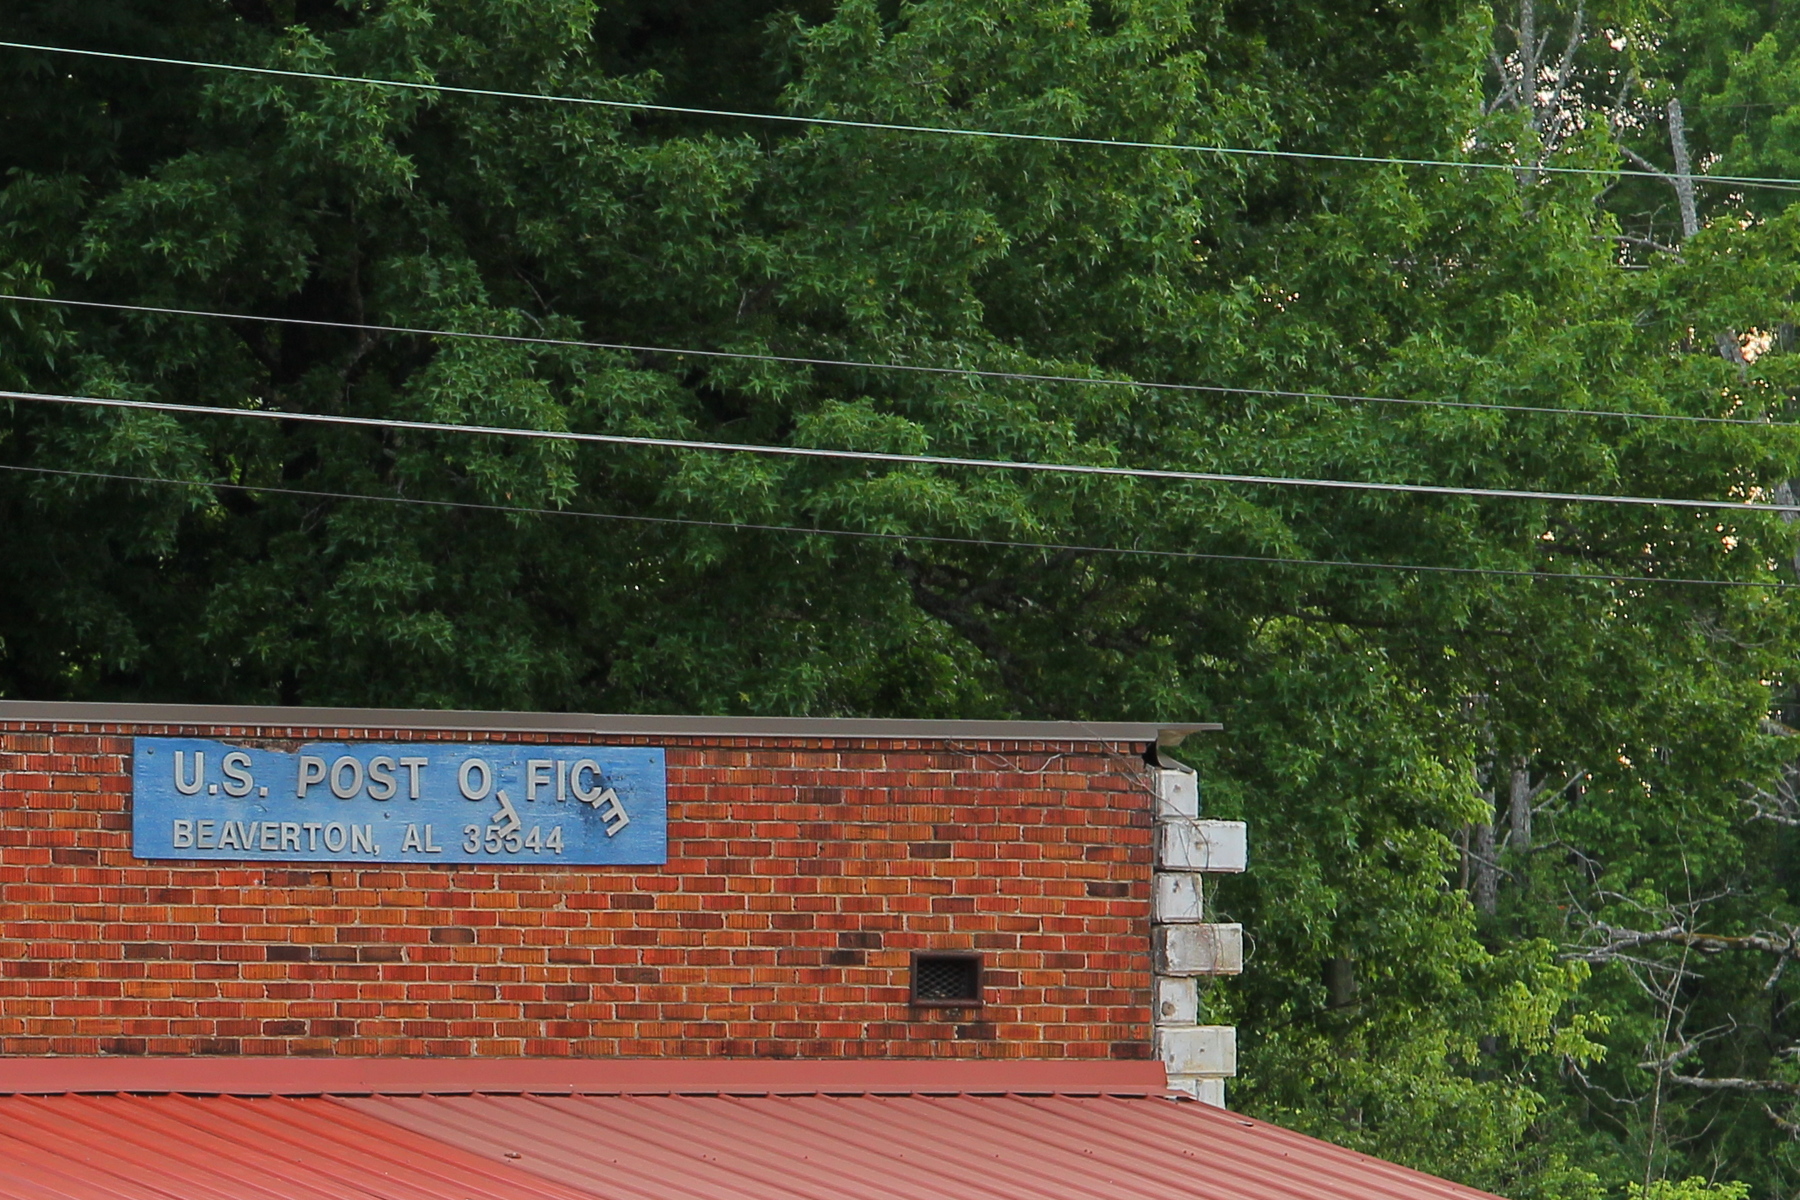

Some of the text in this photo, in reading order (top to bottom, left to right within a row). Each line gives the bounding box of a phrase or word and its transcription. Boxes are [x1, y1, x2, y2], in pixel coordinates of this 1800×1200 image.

[173, 750, 269, 799] U.S.
[296, 755, 429, 801] POST
[172, 818, 382, 856] BEAVERTON,
[401, 824, 442, 854] AL
